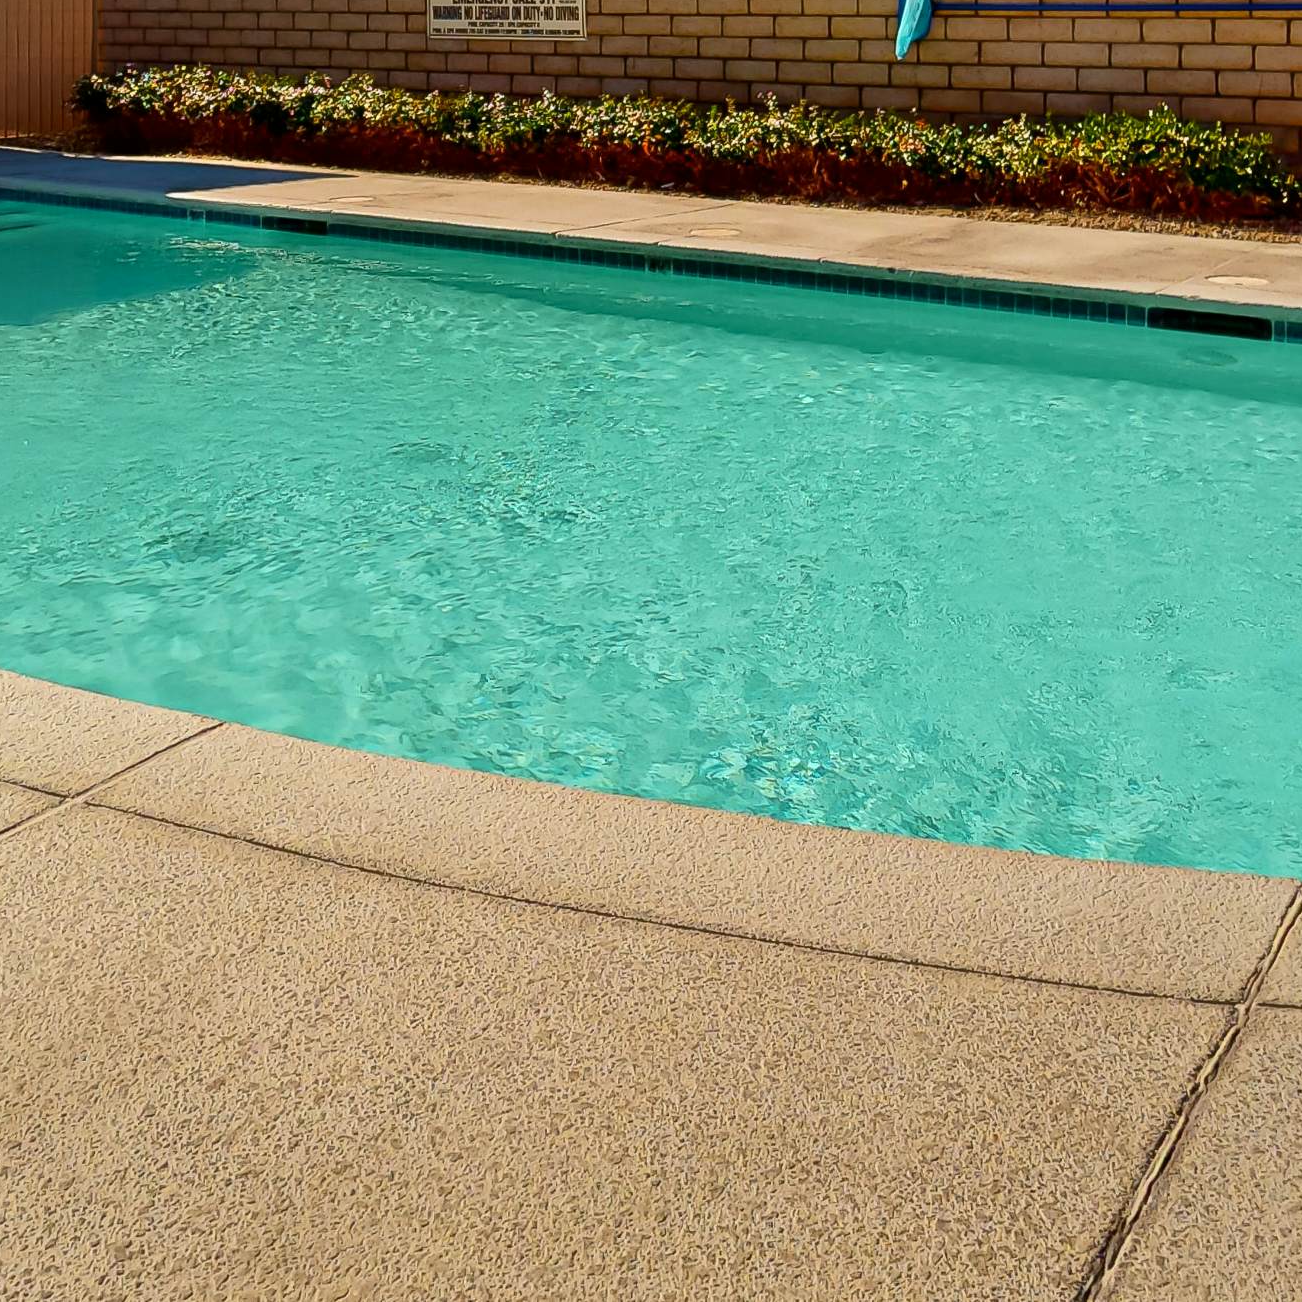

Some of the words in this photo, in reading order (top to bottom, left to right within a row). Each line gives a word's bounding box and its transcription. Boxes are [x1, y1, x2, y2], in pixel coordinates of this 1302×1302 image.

[432, 5, 462, 20] WARNING
[464, 5, 473, 20] NO
[475, 5, 510, 20] LIFEGUARD
[511, 6, 522, 20] ON
[555, 6, 580, 21] DIVING
